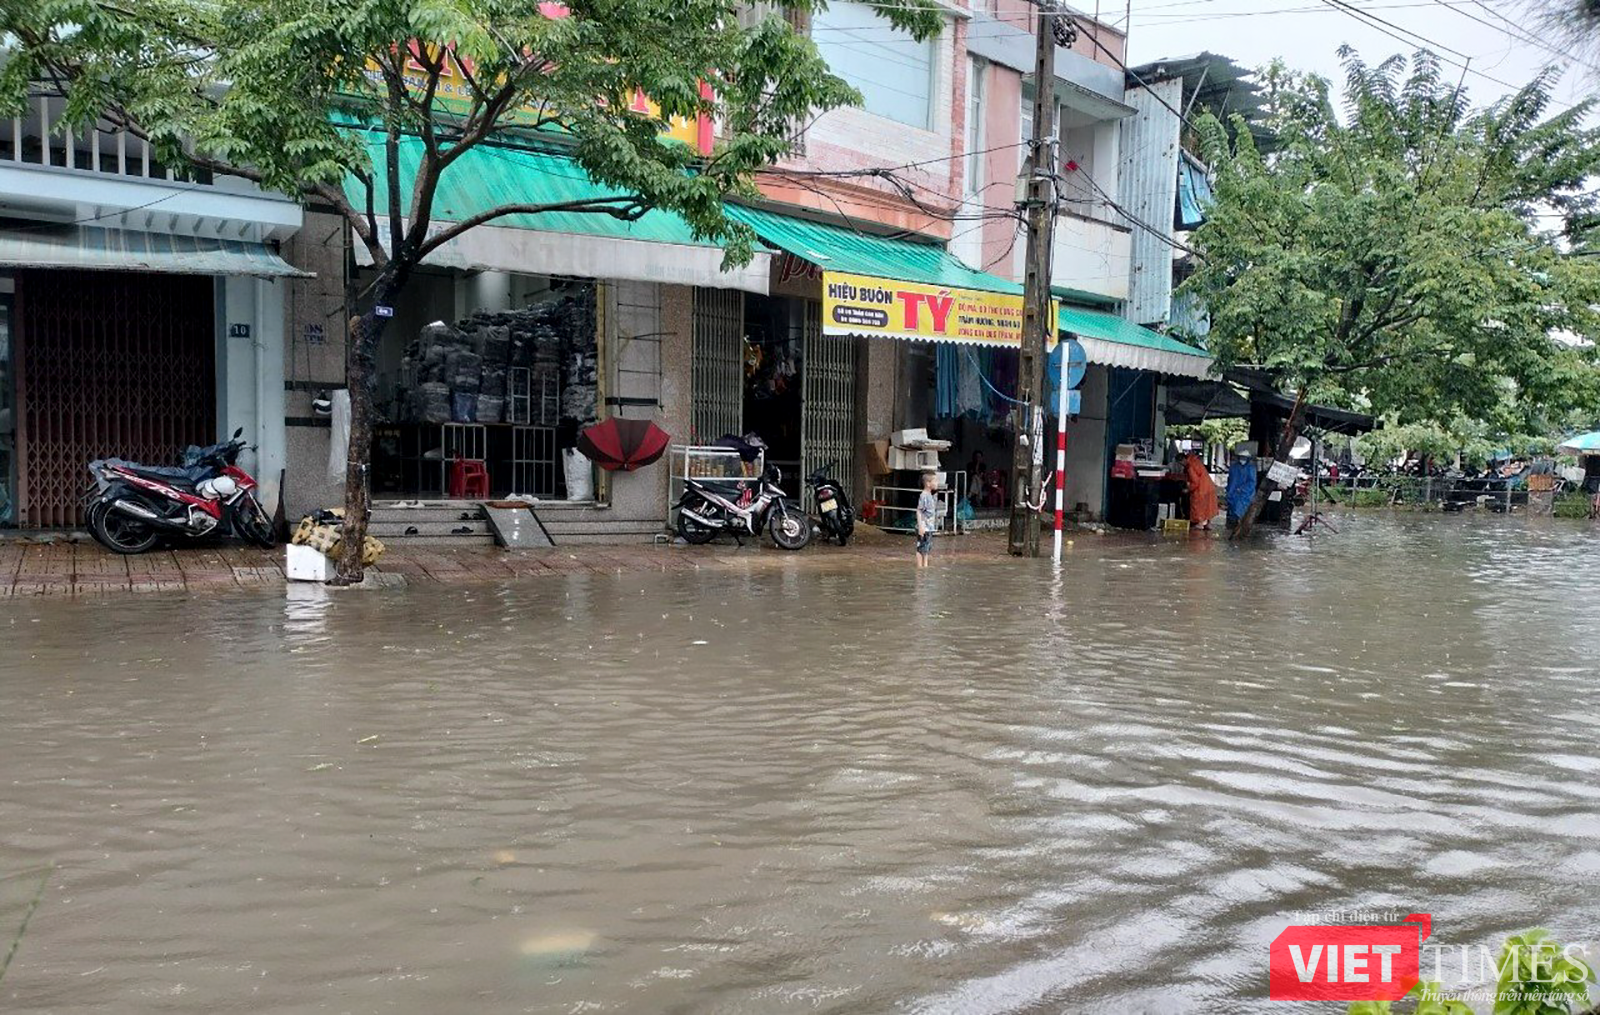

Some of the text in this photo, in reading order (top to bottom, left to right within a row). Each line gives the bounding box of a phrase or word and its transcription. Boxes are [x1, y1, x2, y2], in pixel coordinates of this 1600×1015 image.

[828, 282, 857, 303] HIỆU
[897, 289, 955, 332] TÝ
[233, 325, 246, 336] 10
